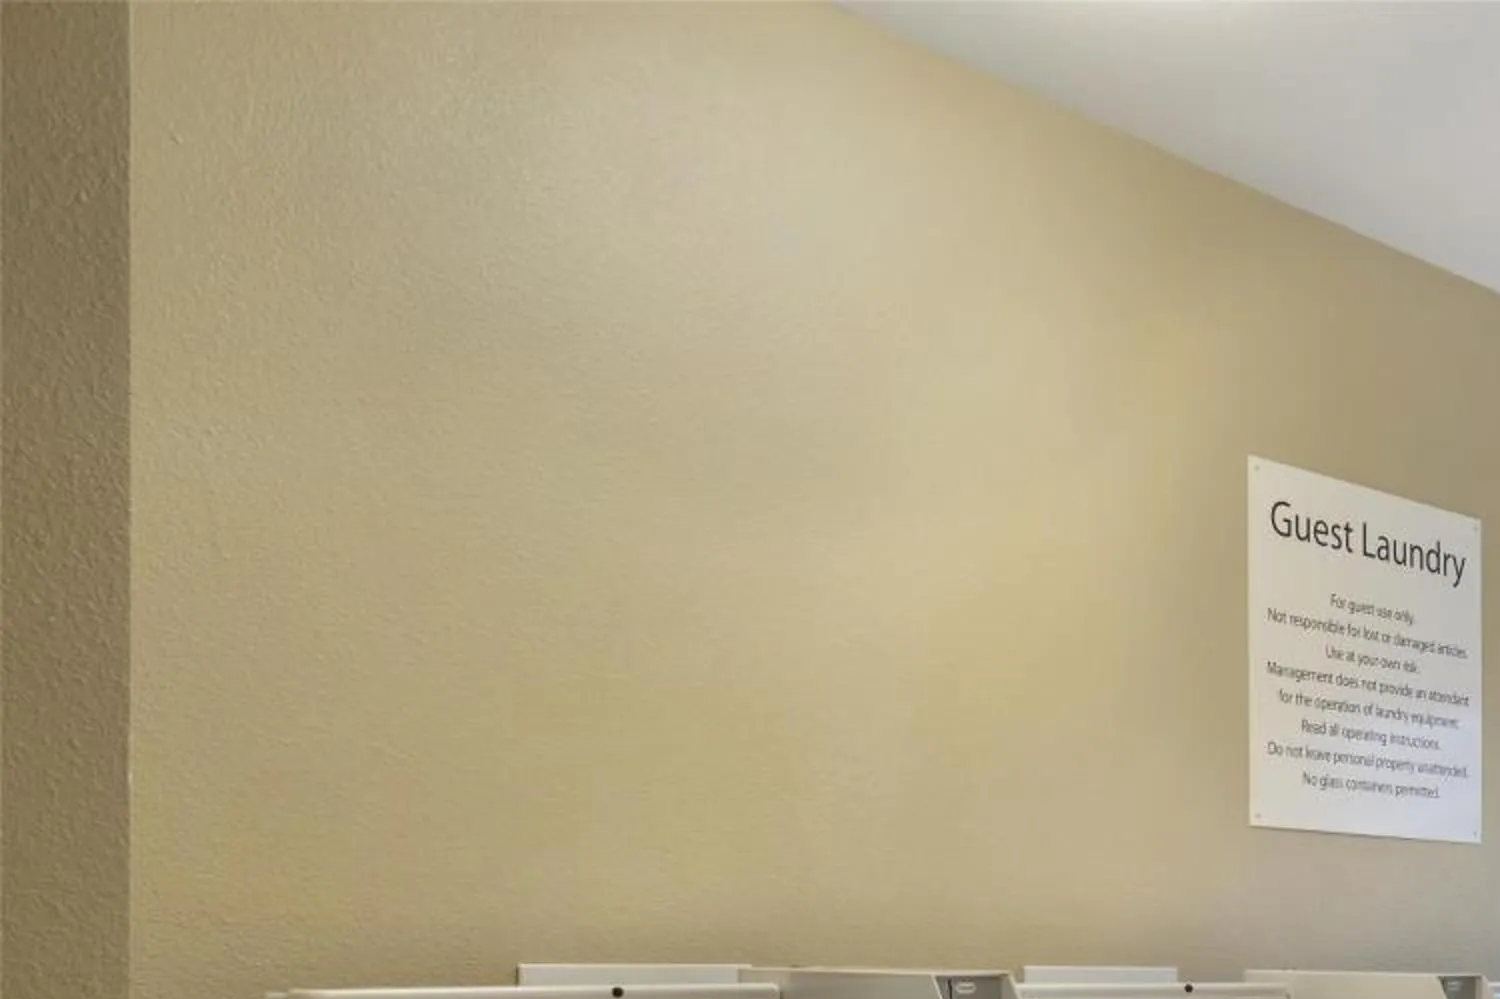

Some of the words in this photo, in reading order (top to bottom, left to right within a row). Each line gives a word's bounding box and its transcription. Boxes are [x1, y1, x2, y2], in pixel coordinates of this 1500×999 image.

[1271, 500, 1353, 553] Guest
[1362, 511, 1466, 588] Laundry
[1330, 593, 1346, 609] For
[1347, 600, 1374, 617] guest
[1376, 607, 1392, 619] use
[1267, 607, 1286, 624] Not
[1289, 615, 1344, 635] responsible
[1347, 623, 1361, 638] for
[1363, 624, 1379, 640] lost
[1381, 633, 1391, 643] or
[1393, 633, 1435, 655] damaged
[1325, 644, 1344, 661] Use
[1345, 650, 1355, 662] at
[1357, 653, 1379, 669] your
[1380, 657, 1400, 670] own
[1265, 660, 1333, 684] Management
[1335, 673, 1359, 689] does
[1361, 679, 1377, 692] not
[1379, 682, 1413, 697] provide
[1415, 688, 1426, 699] an
[1428, 689, 1469, 707] attendant
[1278, 688, 1293, 704] for
[1295, 692, 1312, 707] the
[1314, 696, 1361, 714] operation
[1363, 703, 1374, 717] of
[1376, 706, 1409, 724] laundry
[1301, 719, 1327, 735] Read
[1329, 722, 1338, 737] all
[1341, 726, 1387, 747] operating
[1267, 741, 1284, 757] Do
[1285, 745, 1302, 759] not
[1305, 744, 1331, 762] leave
[1333, 752, 1375, 768] personal
[1376, 757, 1415, 776] property
[1303, 771, 1318, 787] No
[1319, 774, 1343, 791] glass
[1345, 778, 1393, 795] containers
